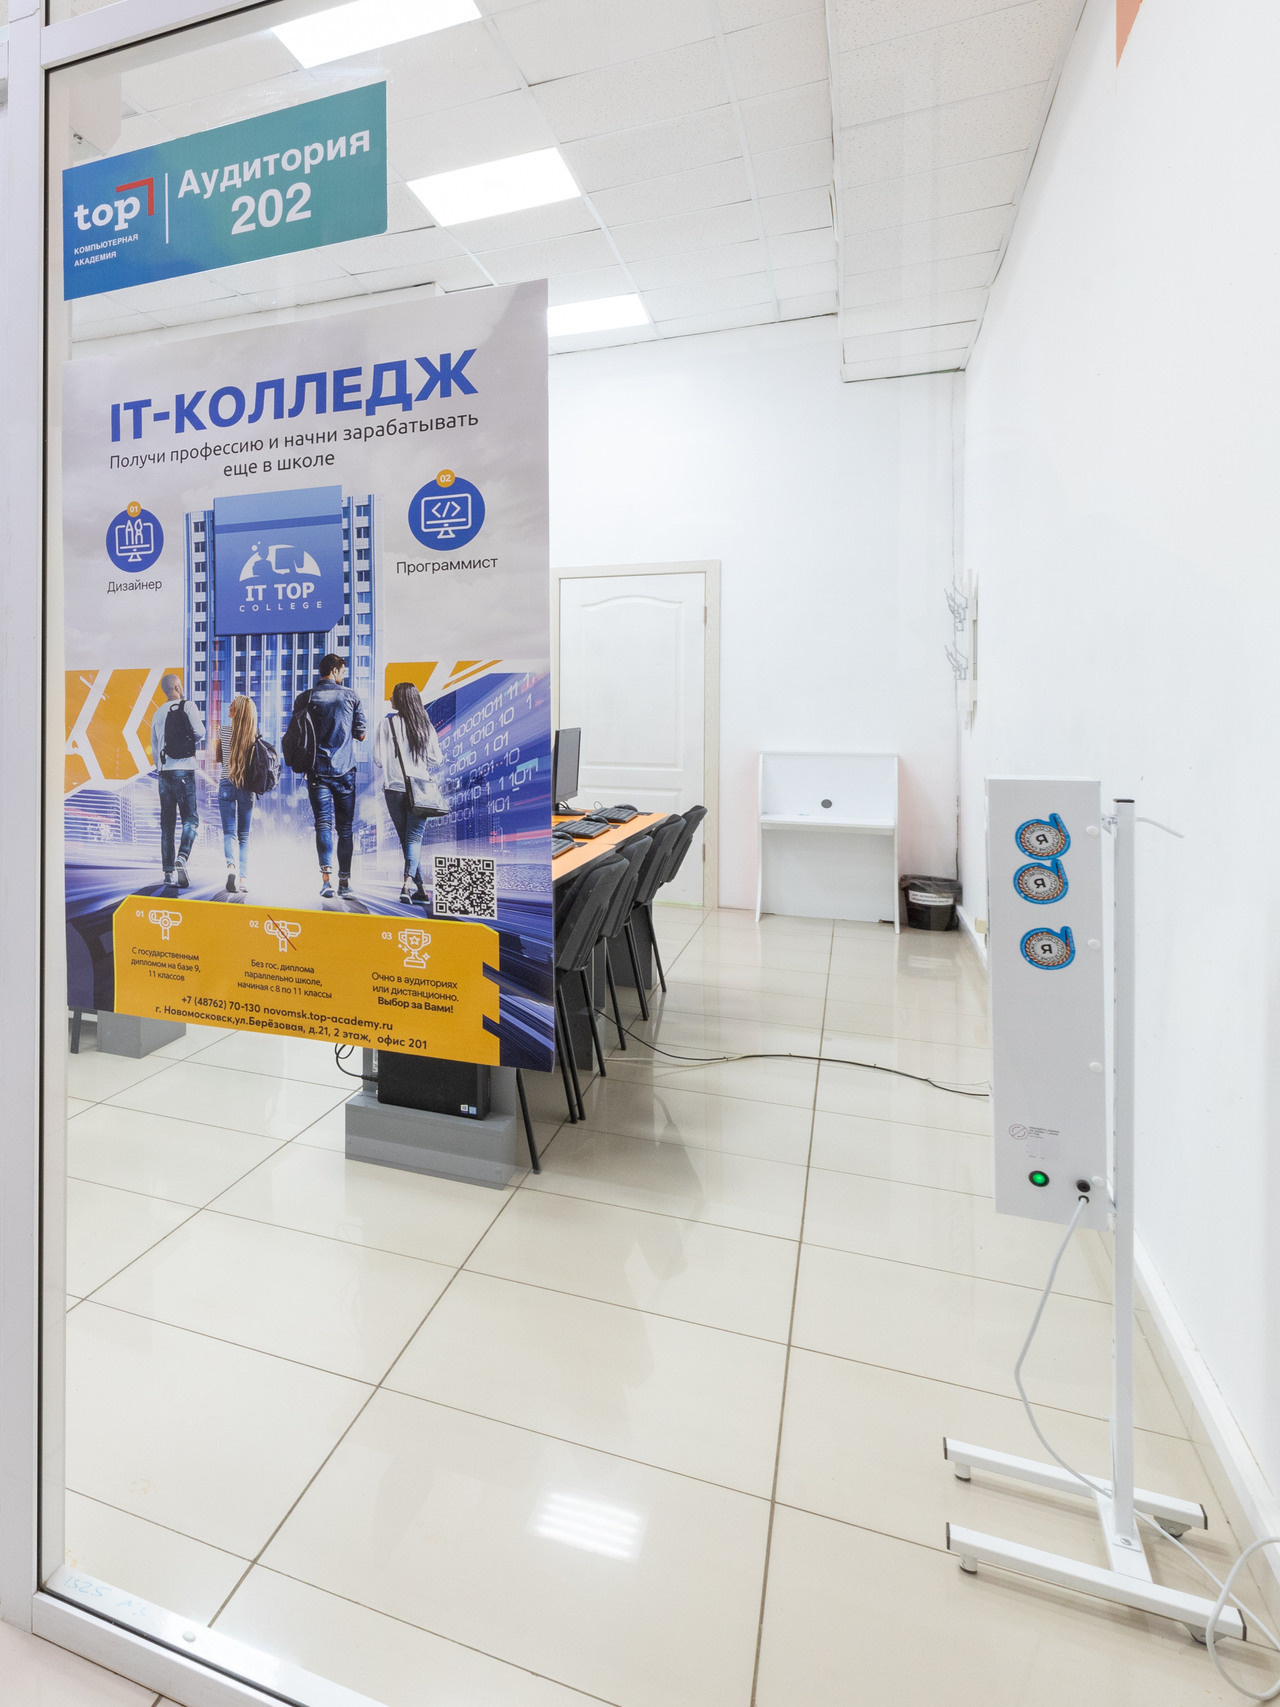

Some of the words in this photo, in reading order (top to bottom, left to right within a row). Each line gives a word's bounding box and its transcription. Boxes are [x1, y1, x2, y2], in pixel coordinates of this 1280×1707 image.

[177, 130, 370, 199] Аудитория
[74, 196, 141, 232] top
[231, 181, 312, 235] 202
[74, 233, 138, 255] КОМПЬЮТЕРНАЯ
[74, 251, 117, 267] АКАДЕМИЯ
[111, 348, 479, 442] IT-КОЛЛЕДЖ
[110, 450, 166, 469] Получи
[170, 437, 264, 463] профессию
[268, 437, 279, 449] и
[284, 430, 338, 448] начни
[343, 413, 479, 443] зарабатывать
[223, 461, 258, 478] еще
[263, 459, 272, 472] в
[277, 453, 335, 471] школе
[439, 473, 452, 483] 02
[129, 505, 138, 513] 01
[396, 556, 499, 575] Программист
[107, 579, 163, 595] Дизайнер
[245, 584, 267, 602] IT
[273, 582, 315, 600] TOP
[239, 600, 322, 612] COLLEGE
[135, 910, 144, 918] 01
[249, 920, 259, 928] 02
[381, 931, 392, 940] 03
[131, 946, 137, 955] С
[138, 948, 199, 961] государственным
[131, 958, 167, 968] дипломом
[177, 962, 193, 972] базе
[194, 964, 201, 973] 9,
[251, 959, 264, 968] Без
[265, 962, 279, 970] гос.
[279, 964, 315, 974] диплома
[157, 972, 185, 981] классов
[244, 971, 294, 983] параллельно
[295, 977, 323, 987] школе,
[371, 971, 395, 983] Очно
[404, 976, 458, 989] аудиториях
[237, 981, 268, 991] начиная
[275, 984, 280, 992] 8
[293, 987, 302, 995] 11
[303, 989, 332, 999] классы
[372, 985, 389, 993] или
[390, 987, 459, 1002] дистанционно.
[181, 995, 192, 1004] +7
[194, 996, 227, 1010] (48762)
[229, 1001, 261, 1013] 70-130
[263, 1006, 393, 1031] novomsk.top-academy.ru
[378, 996, 410, 1009] Выбор
[424, 1002, 454, 1014] Вами!
[308, 1026, 331, 1037] д.21,
[333, 1028, 340, 1036] 2
[342, 1031, 371, 1043] этаж,
[377, 1035, 405, 1046] офис
[408, 1038, 427, 1049] 201
